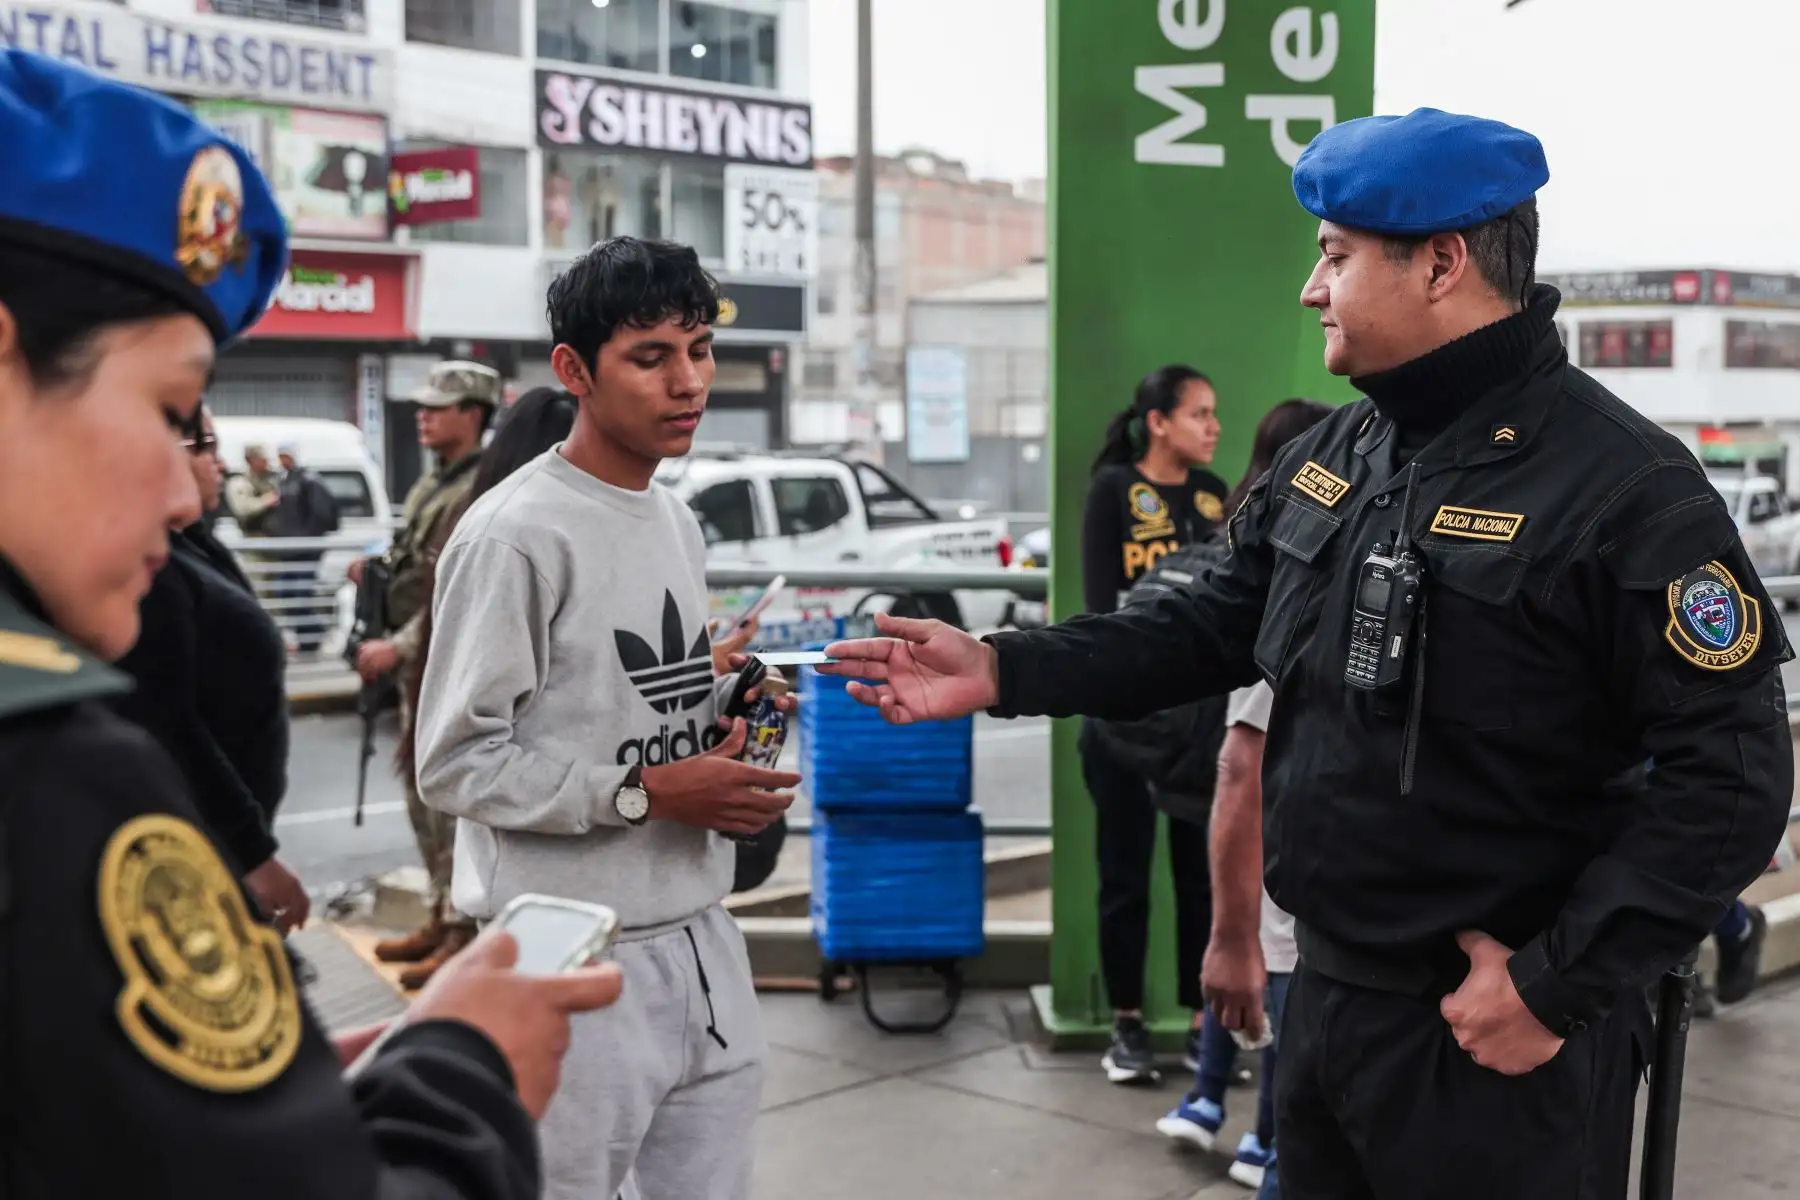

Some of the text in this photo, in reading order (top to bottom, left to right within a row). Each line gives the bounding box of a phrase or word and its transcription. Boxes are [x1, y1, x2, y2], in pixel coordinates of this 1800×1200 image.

[144, 23, 377, 99] HASSDENT
[1245, 6, 1340, 169] de
[1437, 512, 1515, 534] POLICIA NACIONAL
[1705, 564, 1734, 588] FERROVIARIA
[1693, 632, 1756, 665] DIVSEFER
[616, 718, 722, 769] adid
